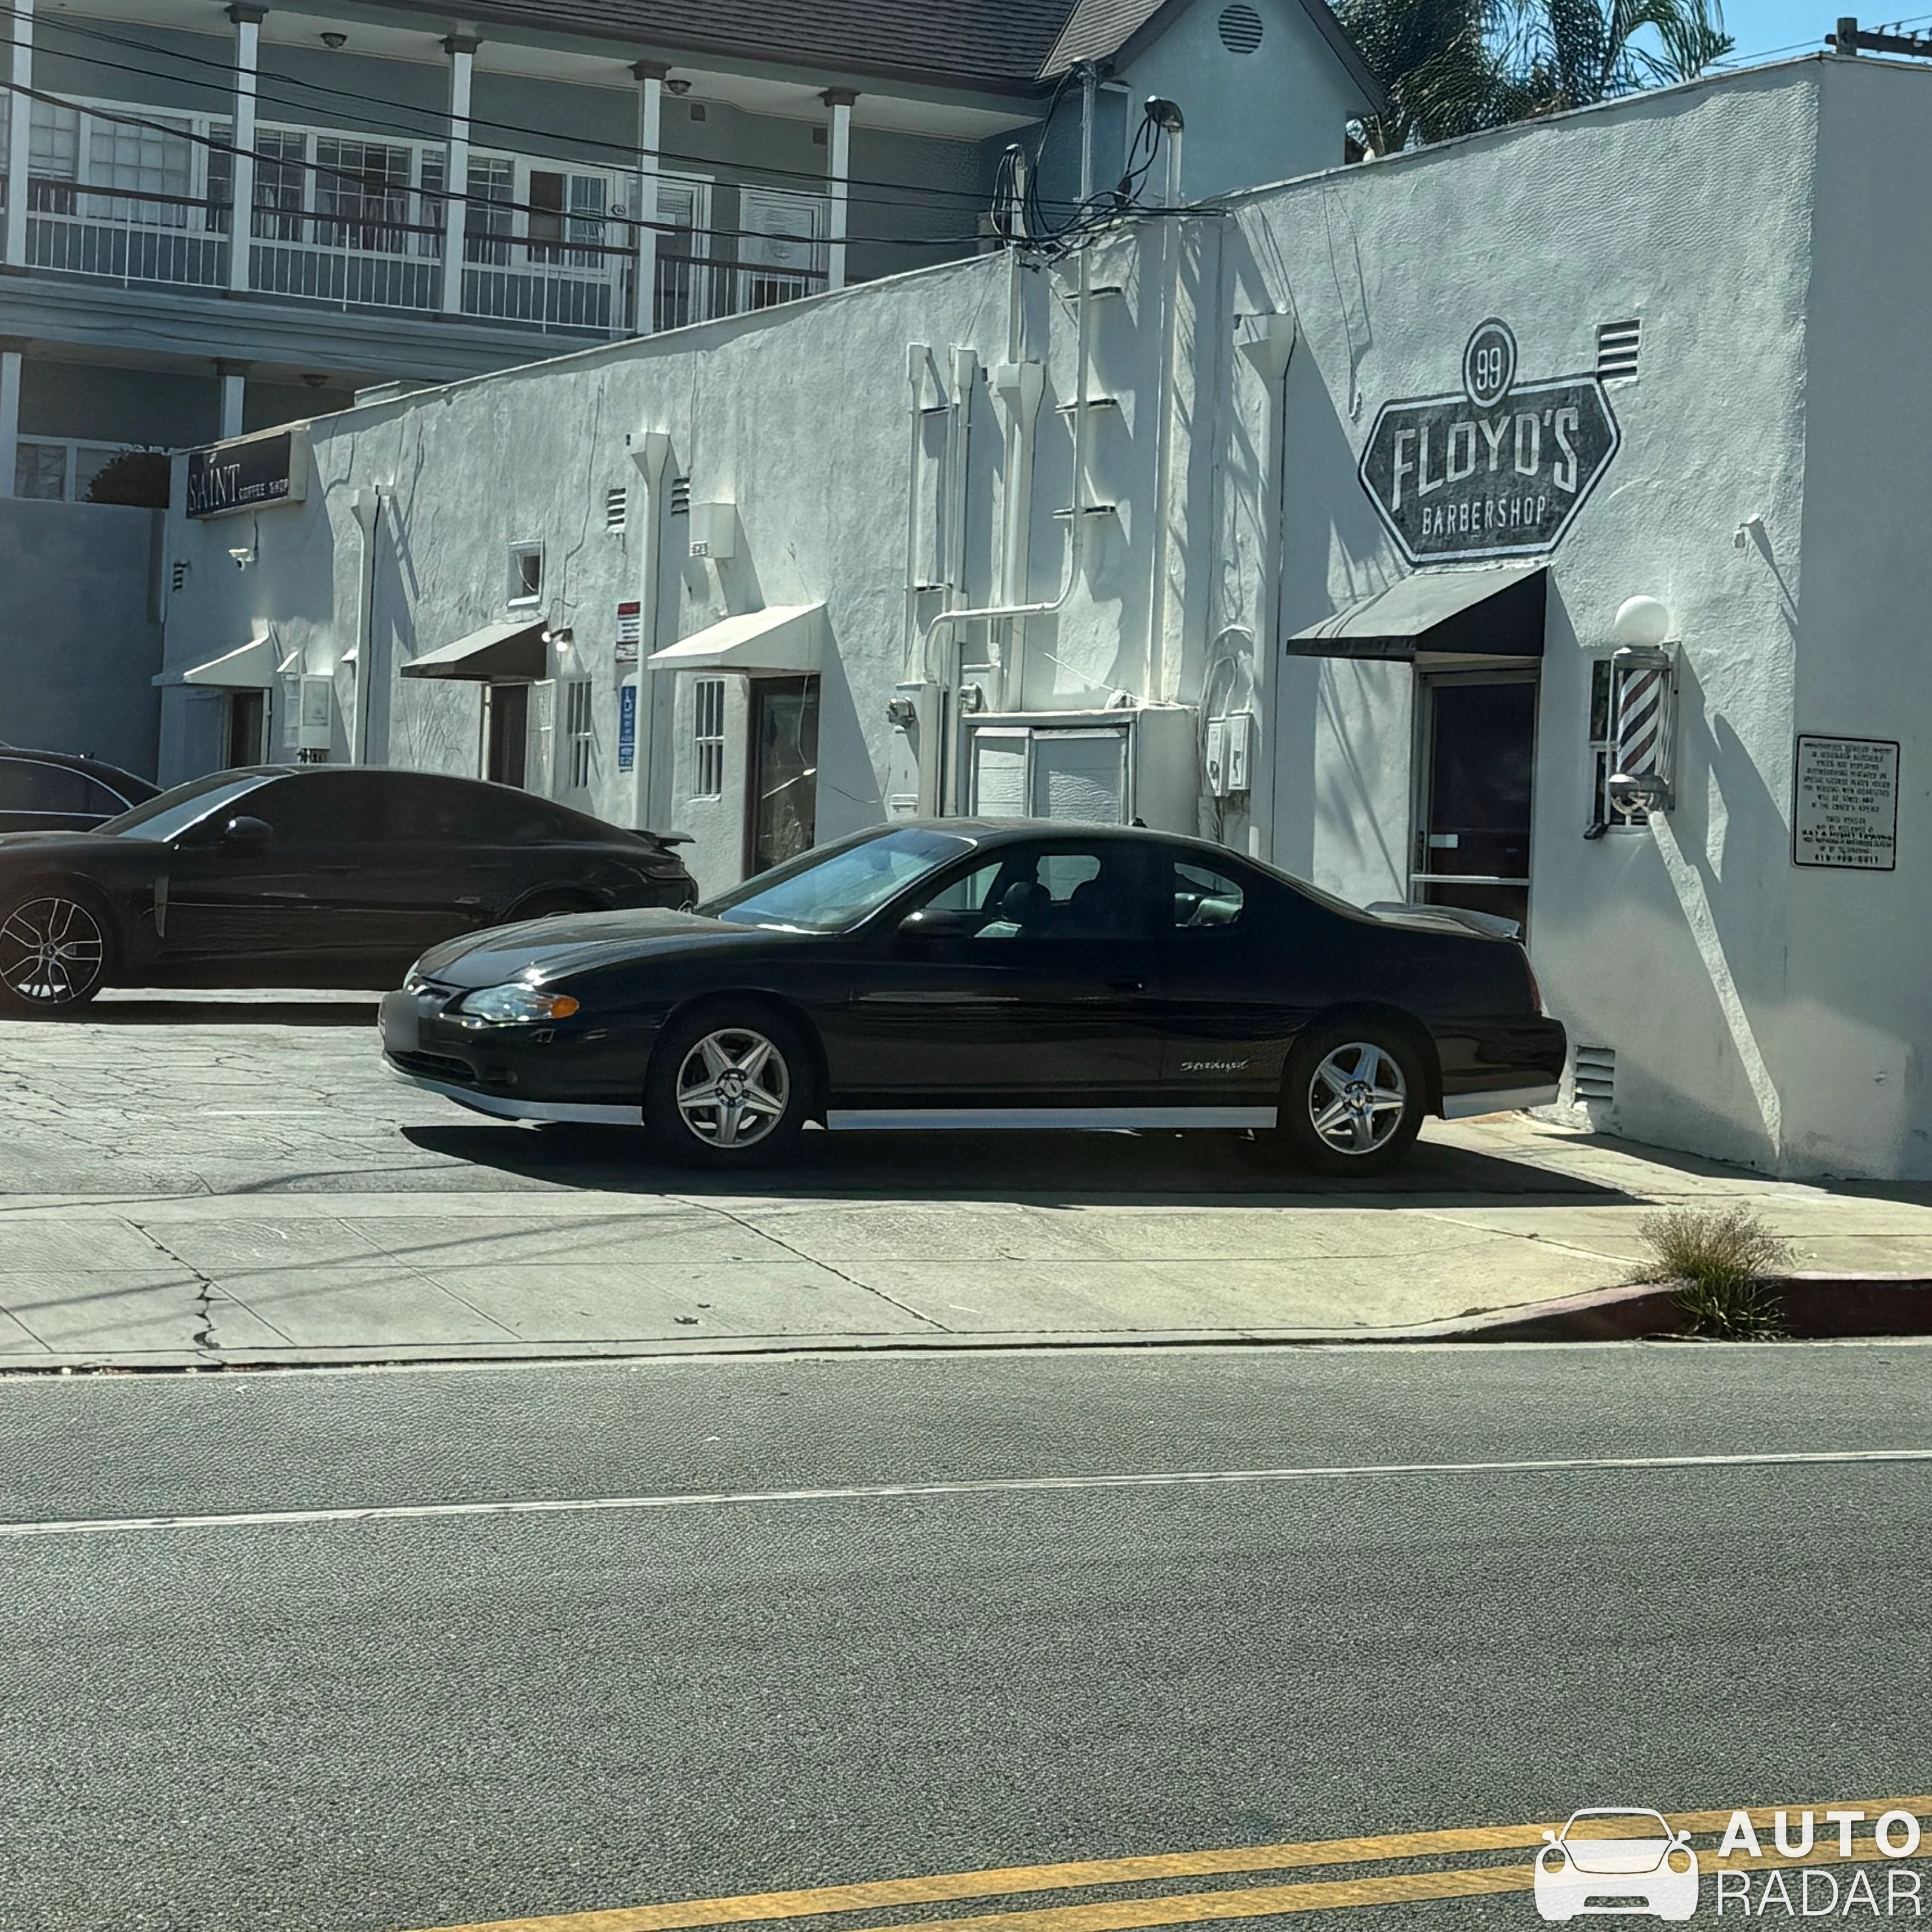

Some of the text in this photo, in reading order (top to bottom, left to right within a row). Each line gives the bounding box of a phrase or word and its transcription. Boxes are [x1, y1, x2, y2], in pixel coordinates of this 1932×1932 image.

[1476, 347, 1502, 390] 99
[1392, 407, 1579, 513] FLOYD'S
[189, 463, 241, 511] SAINT
[1422, 496, 1546, 535] BARBERSHOP
